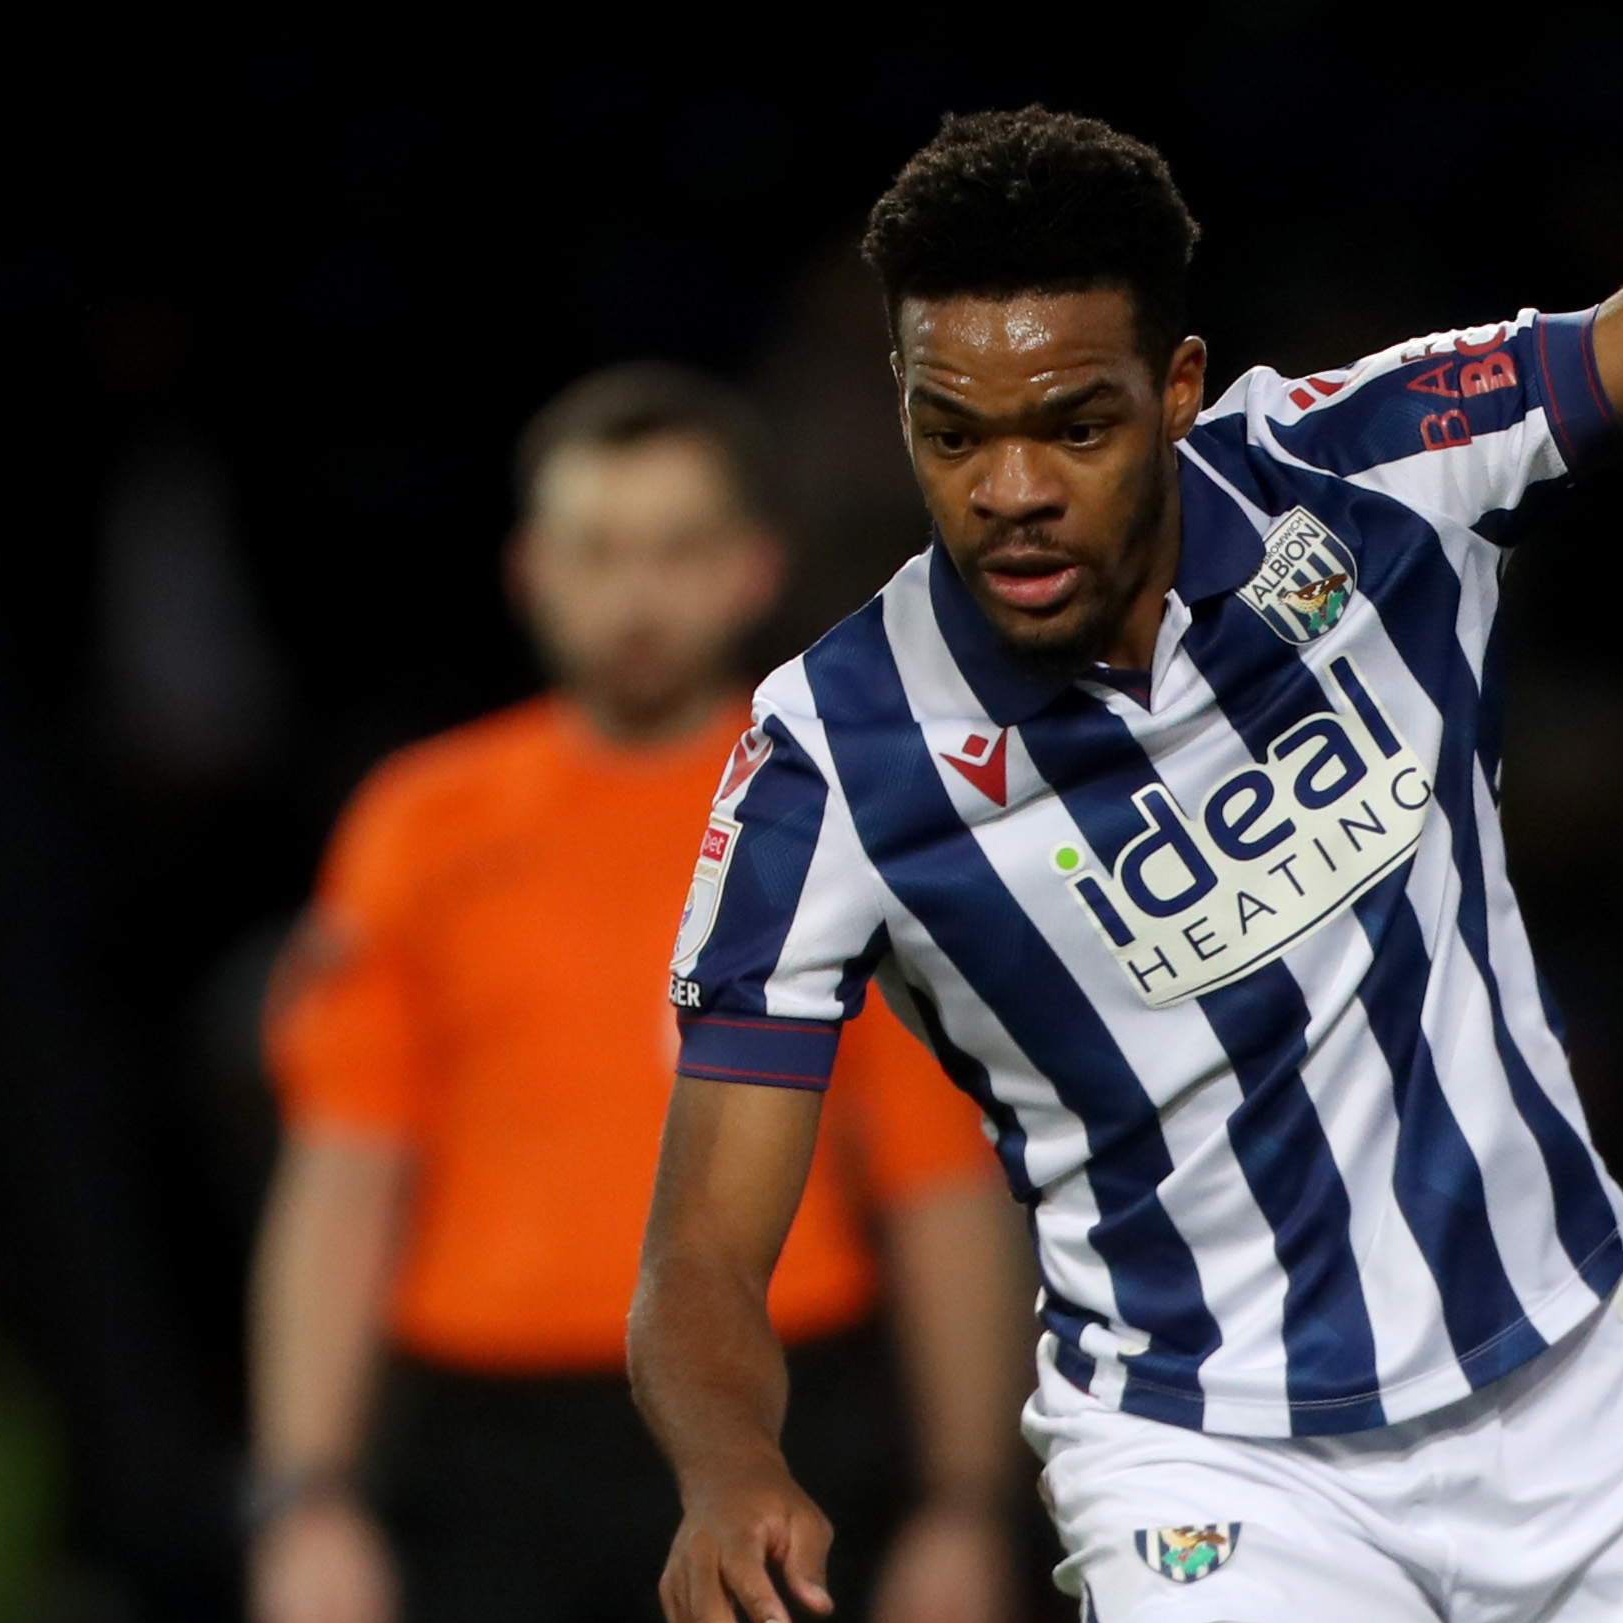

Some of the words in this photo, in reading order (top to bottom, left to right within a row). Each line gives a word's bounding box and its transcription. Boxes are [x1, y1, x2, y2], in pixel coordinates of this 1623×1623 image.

[1252, 523, 1321, 605] ALBION
[1051, 655, 1403, 948] ideal
[1128, 766, 1433, 994] HEATING
